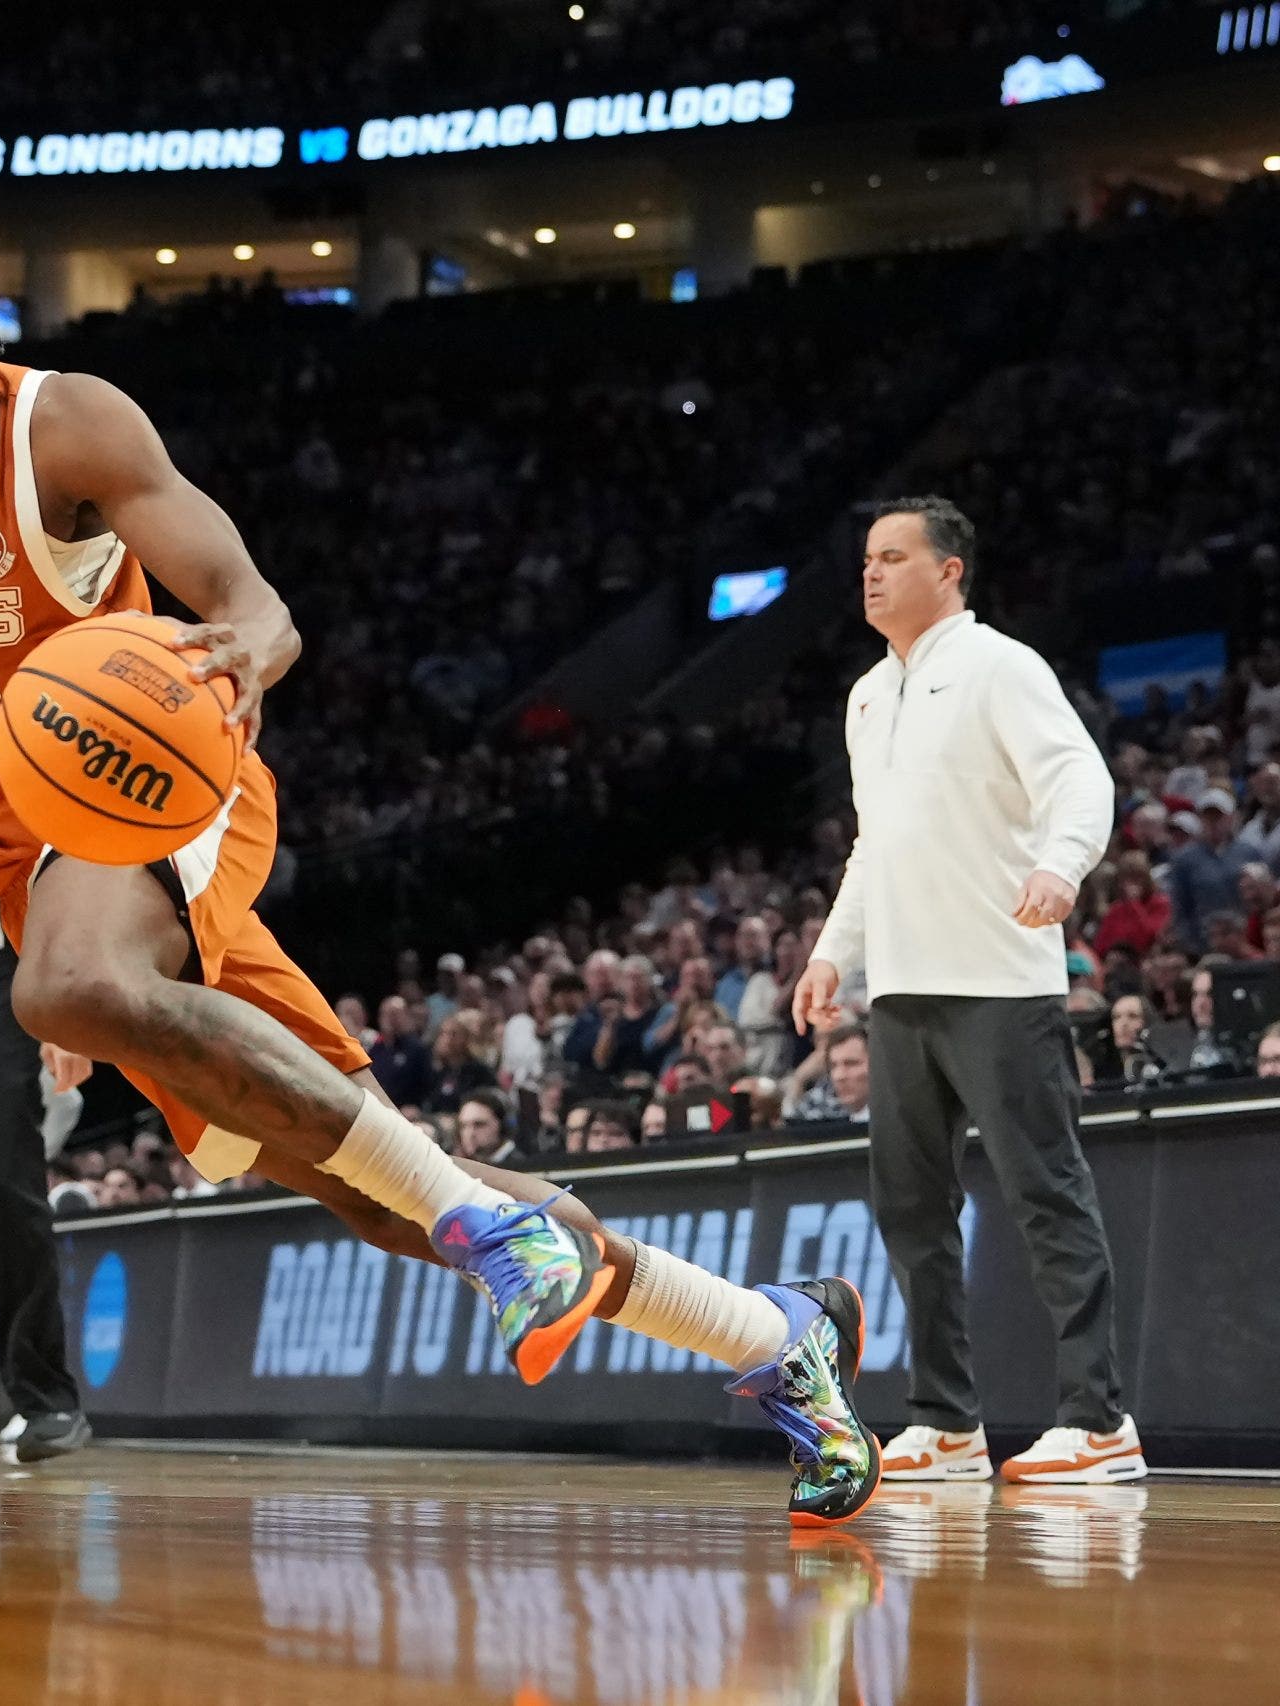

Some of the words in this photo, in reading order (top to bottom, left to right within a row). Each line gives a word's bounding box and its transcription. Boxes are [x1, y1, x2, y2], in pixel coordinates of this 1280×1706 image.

[10, 126, 285, 176] LONGHORNS
[357, 102, 558, 160] GONZAGA
[563, 77, 795, 140] BULLDOGS
[32, 693, 174, 813] Wilson
[252, 1238, 388, 1378] ROAD
[776, 1194, 977, 1373] FOU
